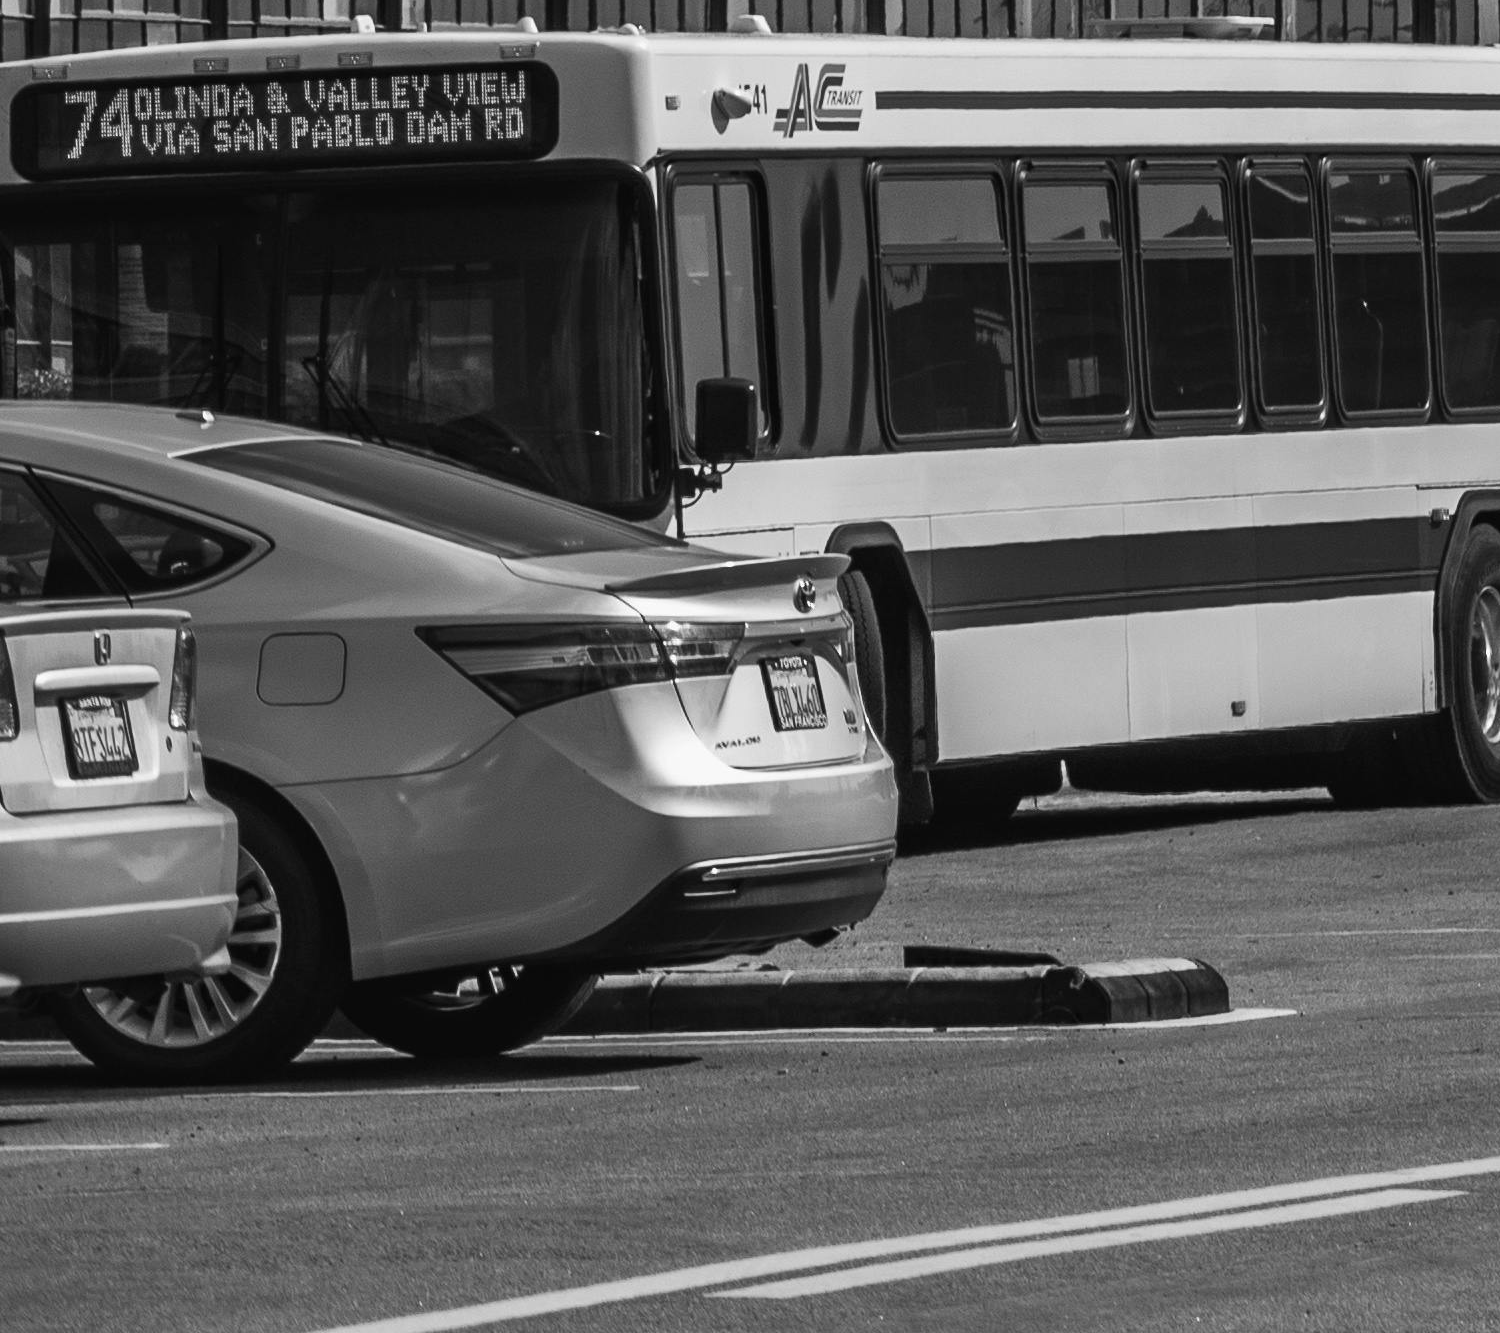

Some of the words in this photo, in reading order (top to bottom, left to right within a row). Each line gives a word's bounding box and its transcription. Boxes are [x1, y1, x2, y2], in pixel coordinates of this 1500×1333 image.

[134, 83, 254, 121] OLINDA
[266, 82, 291, 114] &
[303, 74, 430, 112] VALLEY
[443, 70, 526, 106] VIEW
[826, 90, 863, 106] TRANSIT
[65, 89, 133, 159] 74
[141, 121, 200, 156] VIA
[213, 118, 278, 153] SAN
[291, 112, 394, 149] PABLO
[407, 110, 472, 143] DAM
[485, 107, 524, 140] RD
[779, 656, 803, 668] TOYOTA
[780, 716, 794, 729] SAN
[794, 714, 828, 728] FRANCISCO
[715, 736, 761, 749] AVALON
